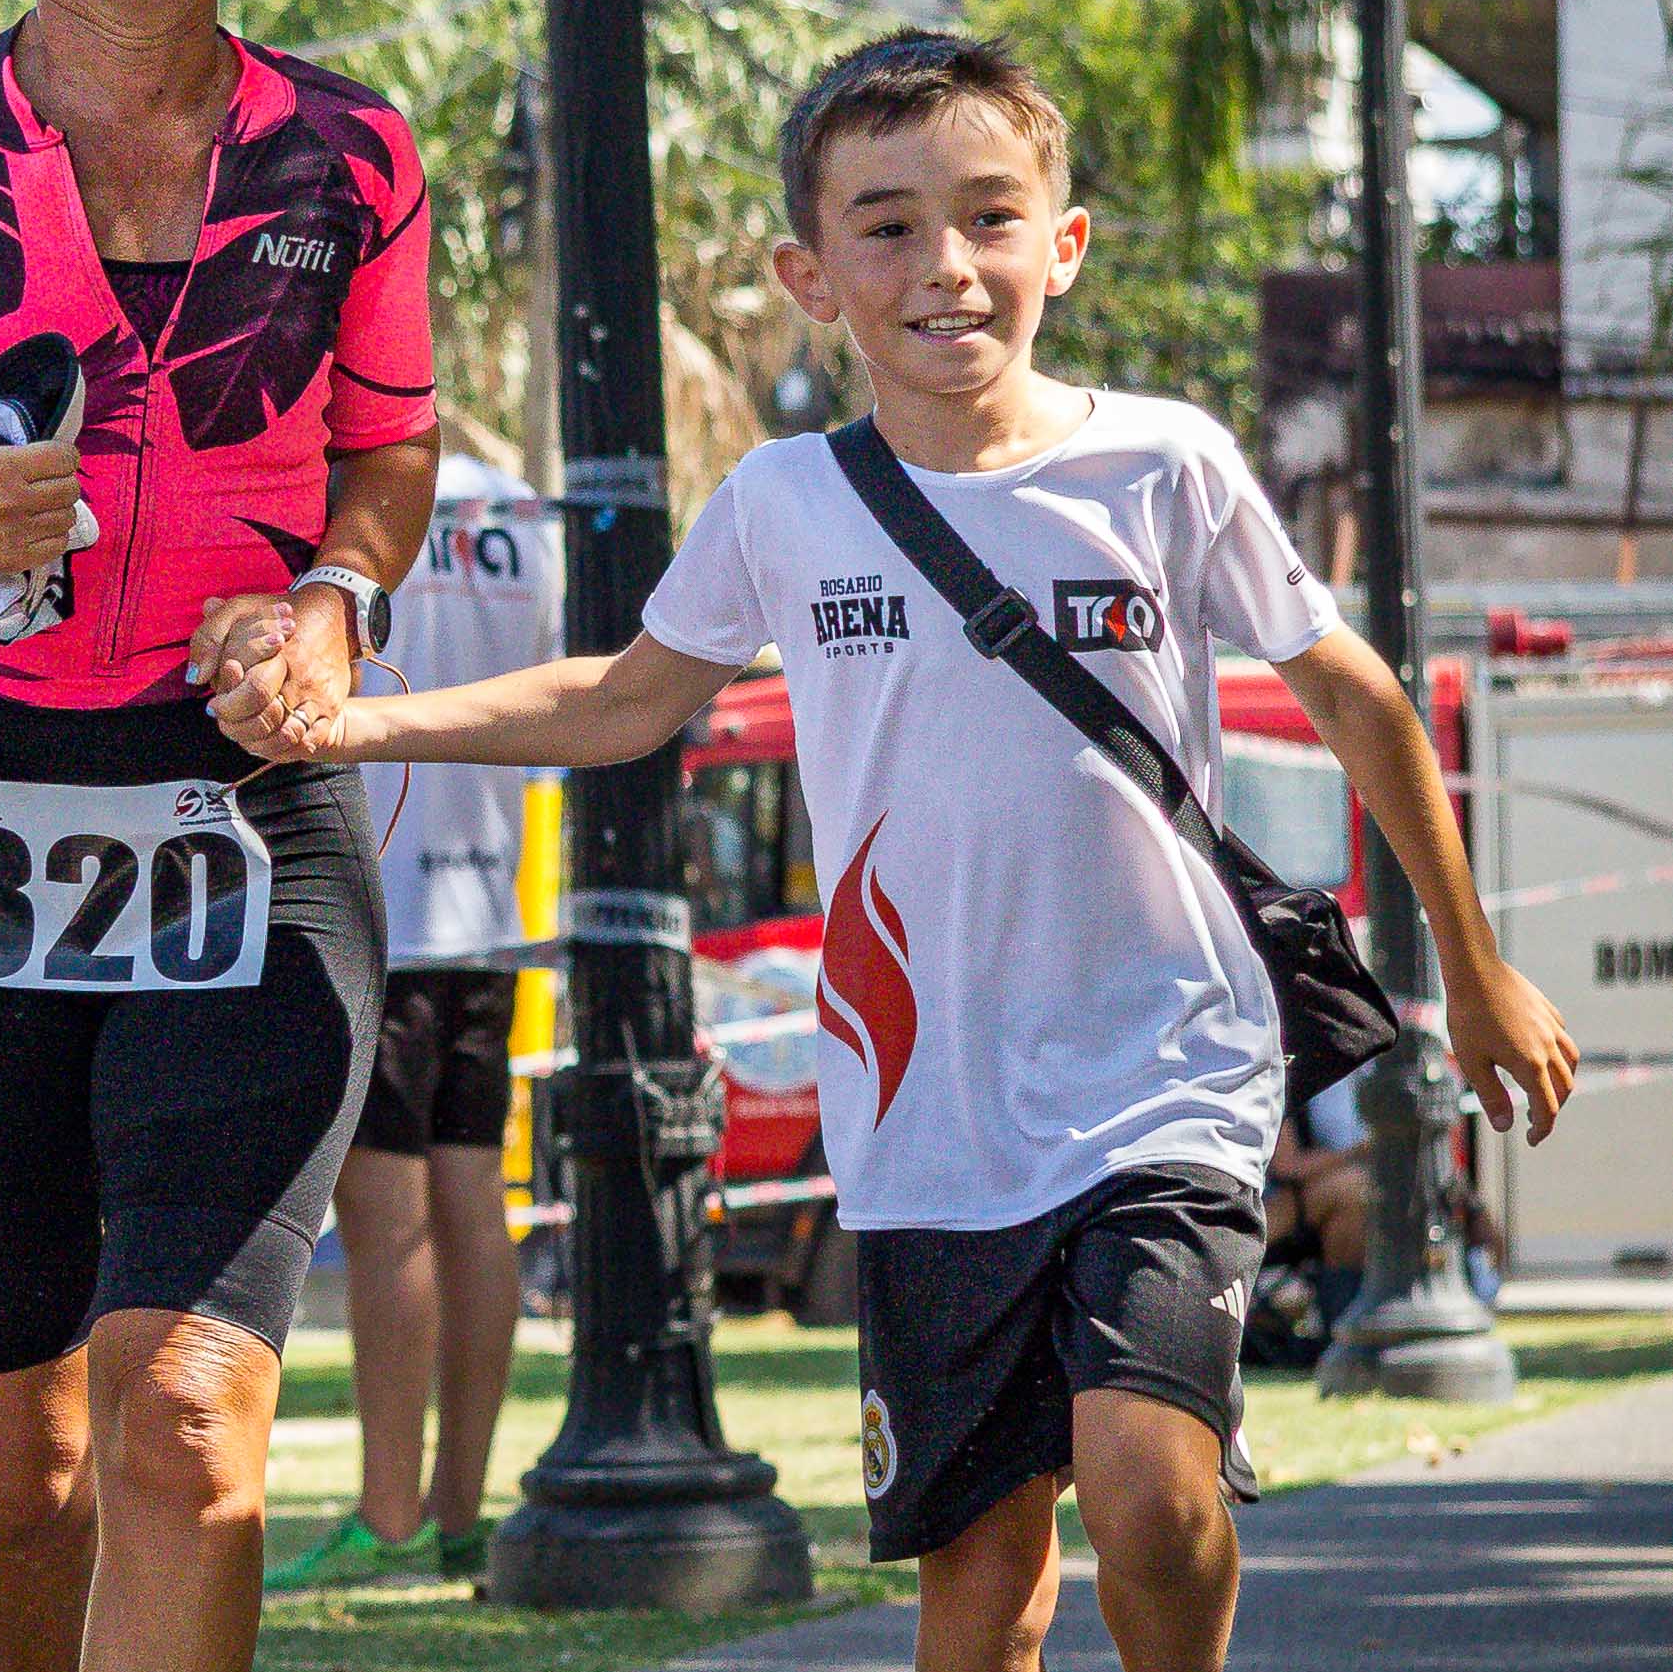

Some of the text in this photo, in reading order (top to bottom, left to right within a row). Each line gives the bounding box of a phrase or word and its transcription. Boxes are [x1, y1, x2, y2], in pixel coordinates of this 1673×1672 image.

[819, 574, 883, 597] ROSARIO
[810, 595, 910, 646] ARENA
[826, 642, 894, 659] SPORTS
